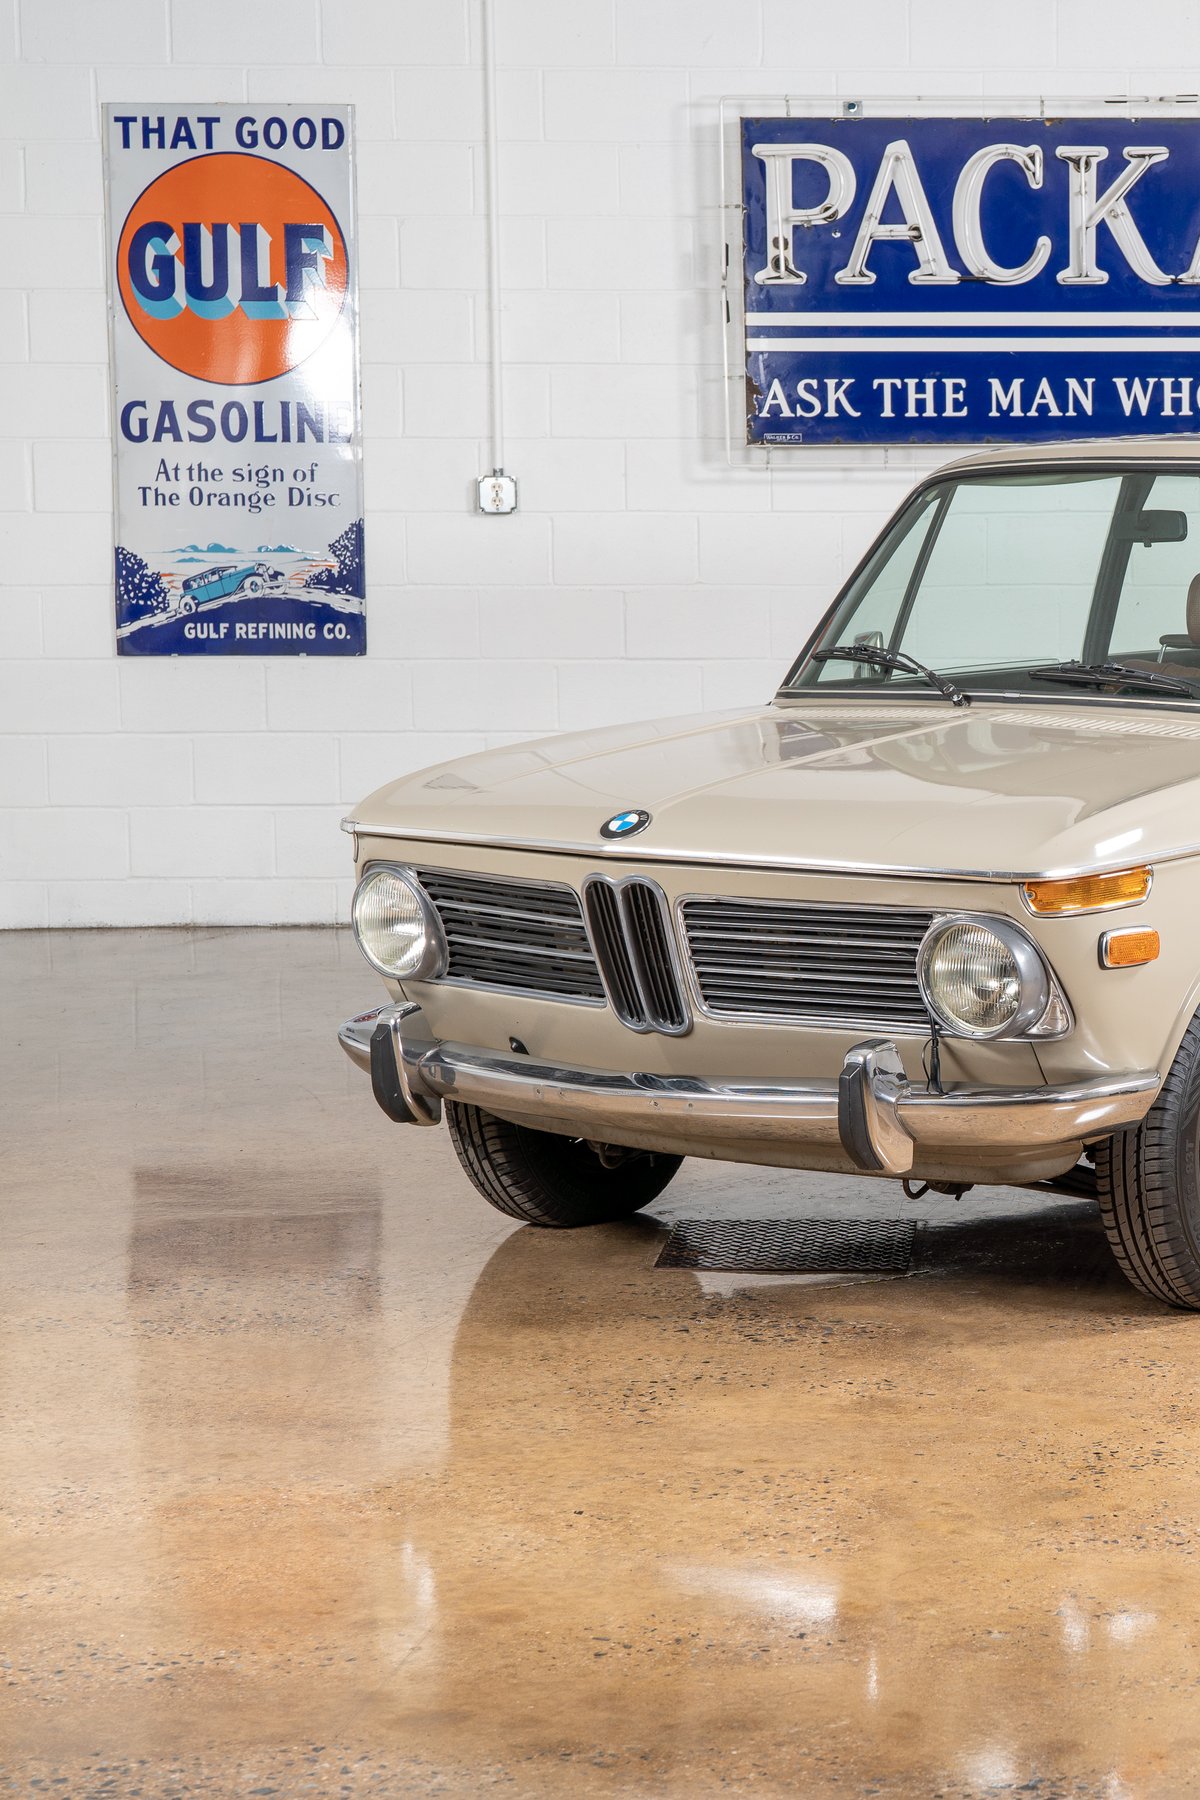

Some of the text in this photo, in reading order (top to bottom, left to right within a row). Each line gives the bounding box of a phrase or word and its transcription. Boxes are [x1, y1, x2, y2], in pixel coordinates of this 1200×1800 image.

[114, 116, 345, 150] THAT GOOD
[128, 221, 333, 320] GULF
[759, 377, 861, 418] ASK
[872, 378, 968, 418] THE
[988, 377, 1096, 417] MAN
[155, 458, 319, 488] At the sign of
[138, 486, 342, 513] The Orange Disc
[184, 622, 351, 640] GULF REFINING CO.
